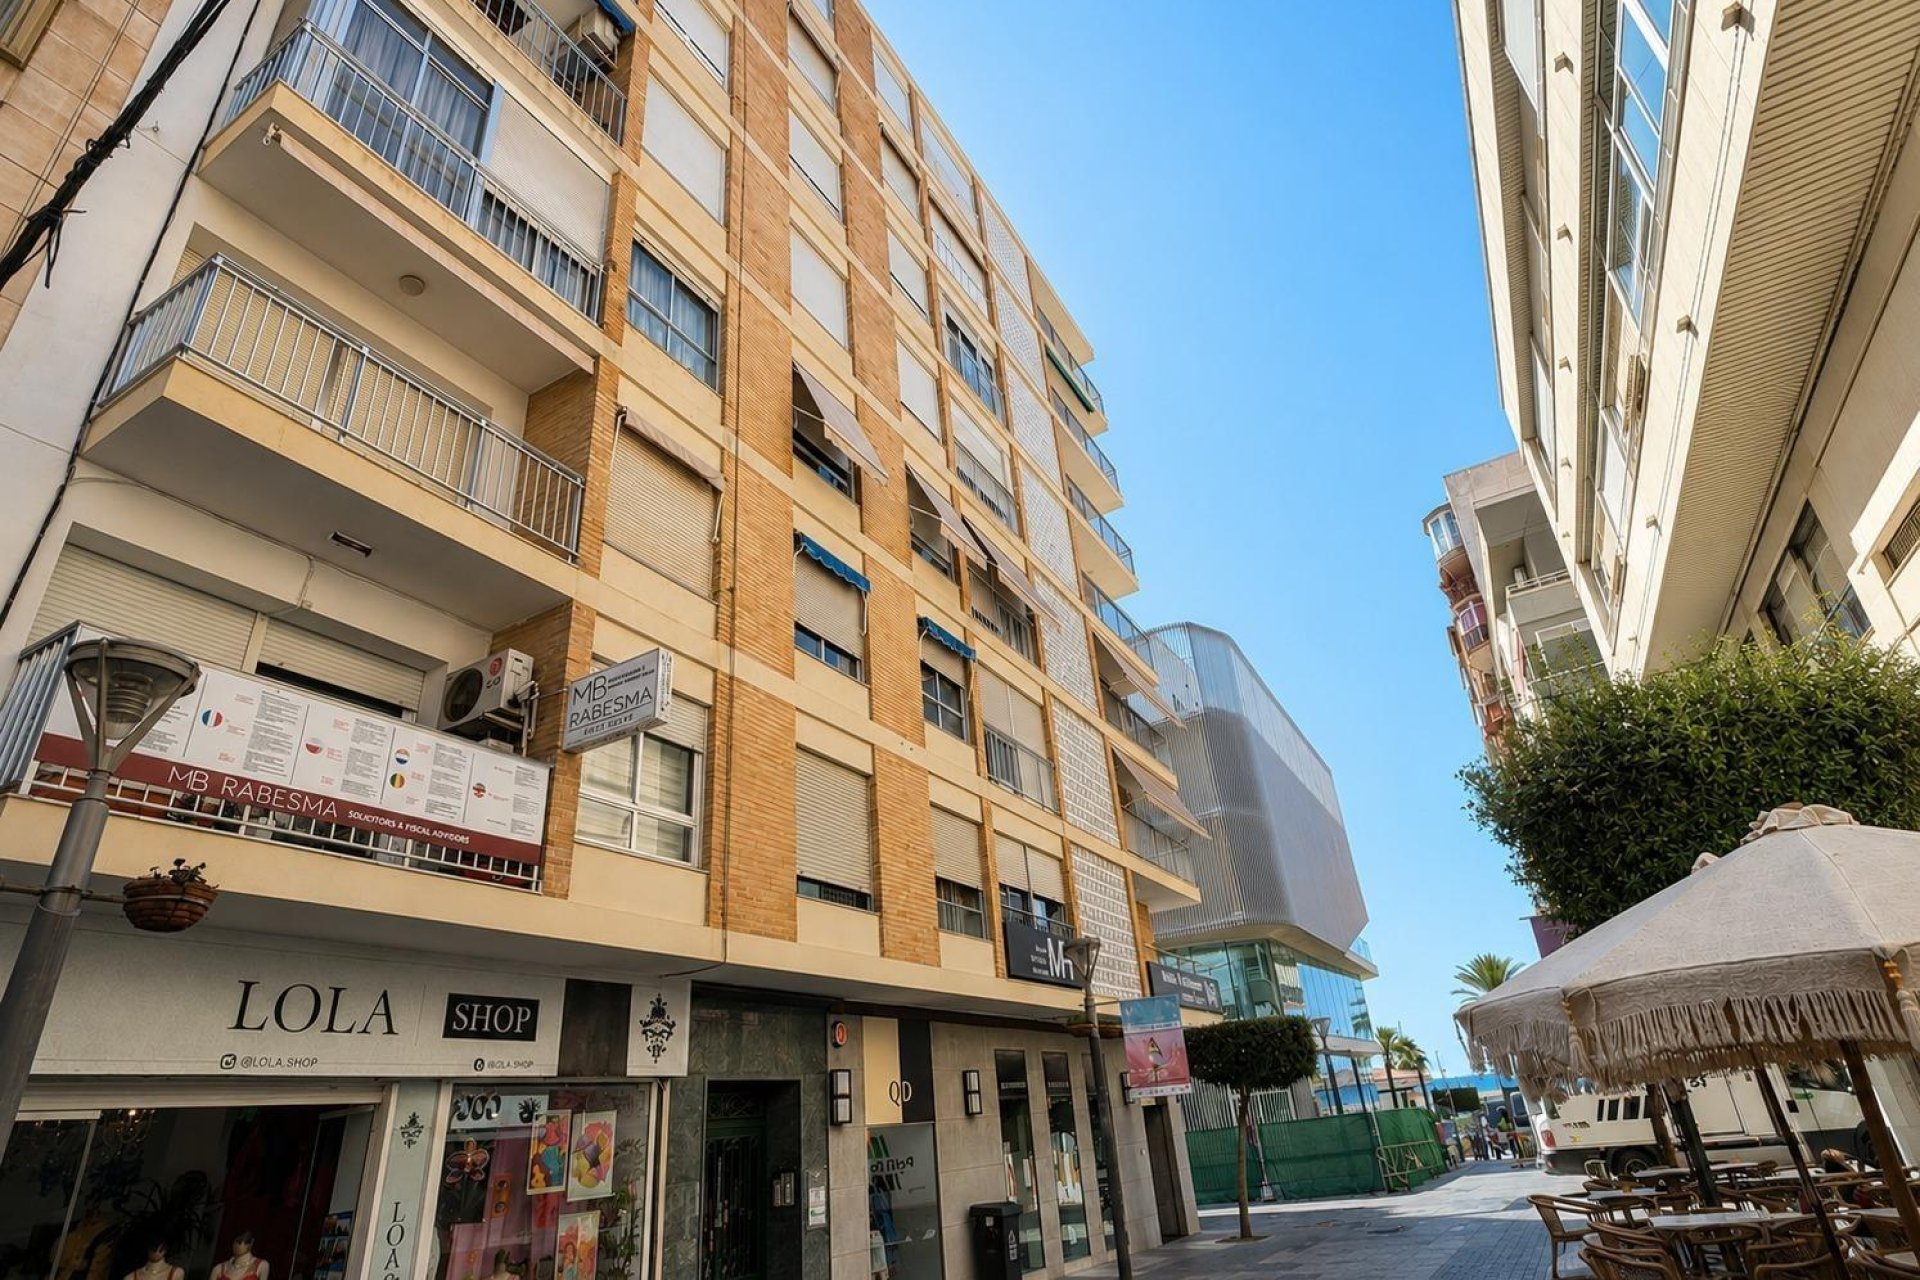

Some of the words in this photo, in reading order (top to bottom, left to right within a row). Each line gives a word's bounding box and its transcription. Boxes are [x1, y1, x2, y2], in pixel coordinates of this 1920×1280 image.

[569, 686, 653, 728] RABESMA
[572, 675, 607, 706] MB
[167, 766, 209, 792] MB
[220, 776, 338, 819] RABESMA
[226, 979, 400, 1036] LOLA
[452, 1002, 532, 1034] SHOP
[240, 1055, 319, 1069] @LOLA.SHOP
